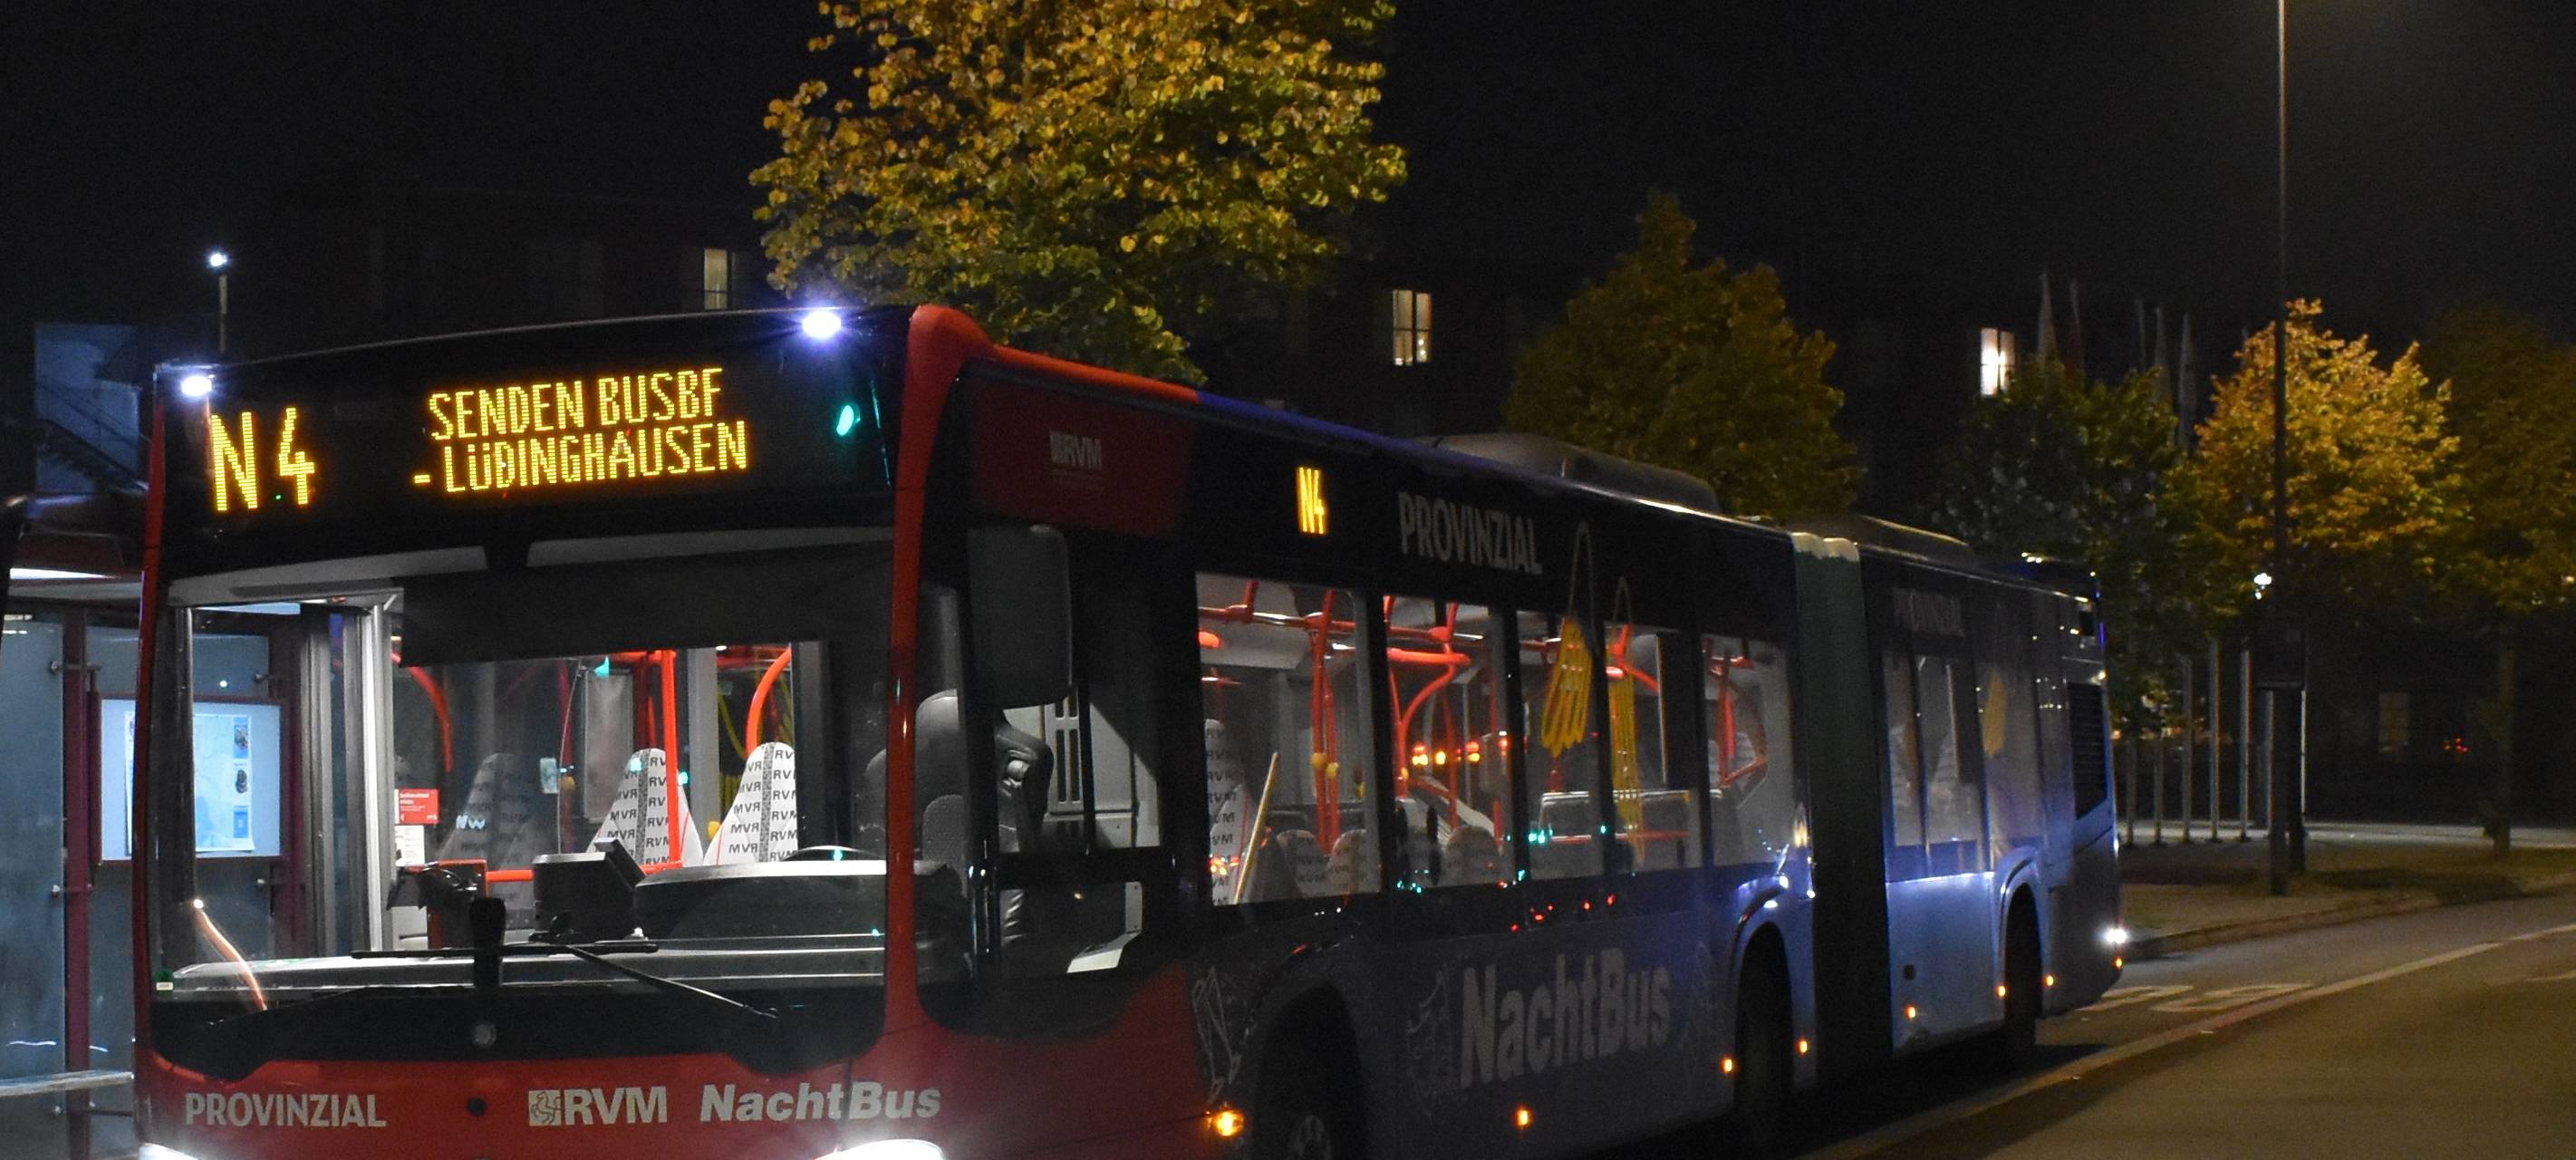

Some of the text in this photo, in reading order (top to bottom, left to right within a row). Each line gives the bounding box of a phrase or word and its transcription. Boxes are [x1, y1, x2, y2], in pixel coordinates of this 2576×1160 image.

[429, 368, 722, 440] SENDEN BUSBF
[209, 407, 315, 511] N 4
[444, 420, 747, 492] LÜDINGHAUSEN
[1298, 466, 1325, 535] N4
[1398, 492, 1541, 575] PROVINZIAL
[1461, 947, 1673, 1088] NachtBus
[185, 1092, 387, 1127] PROVINZIAL
[564, 1086, 668, 1126] RVM
[699, 1081, 941, 1123] NachtBus
